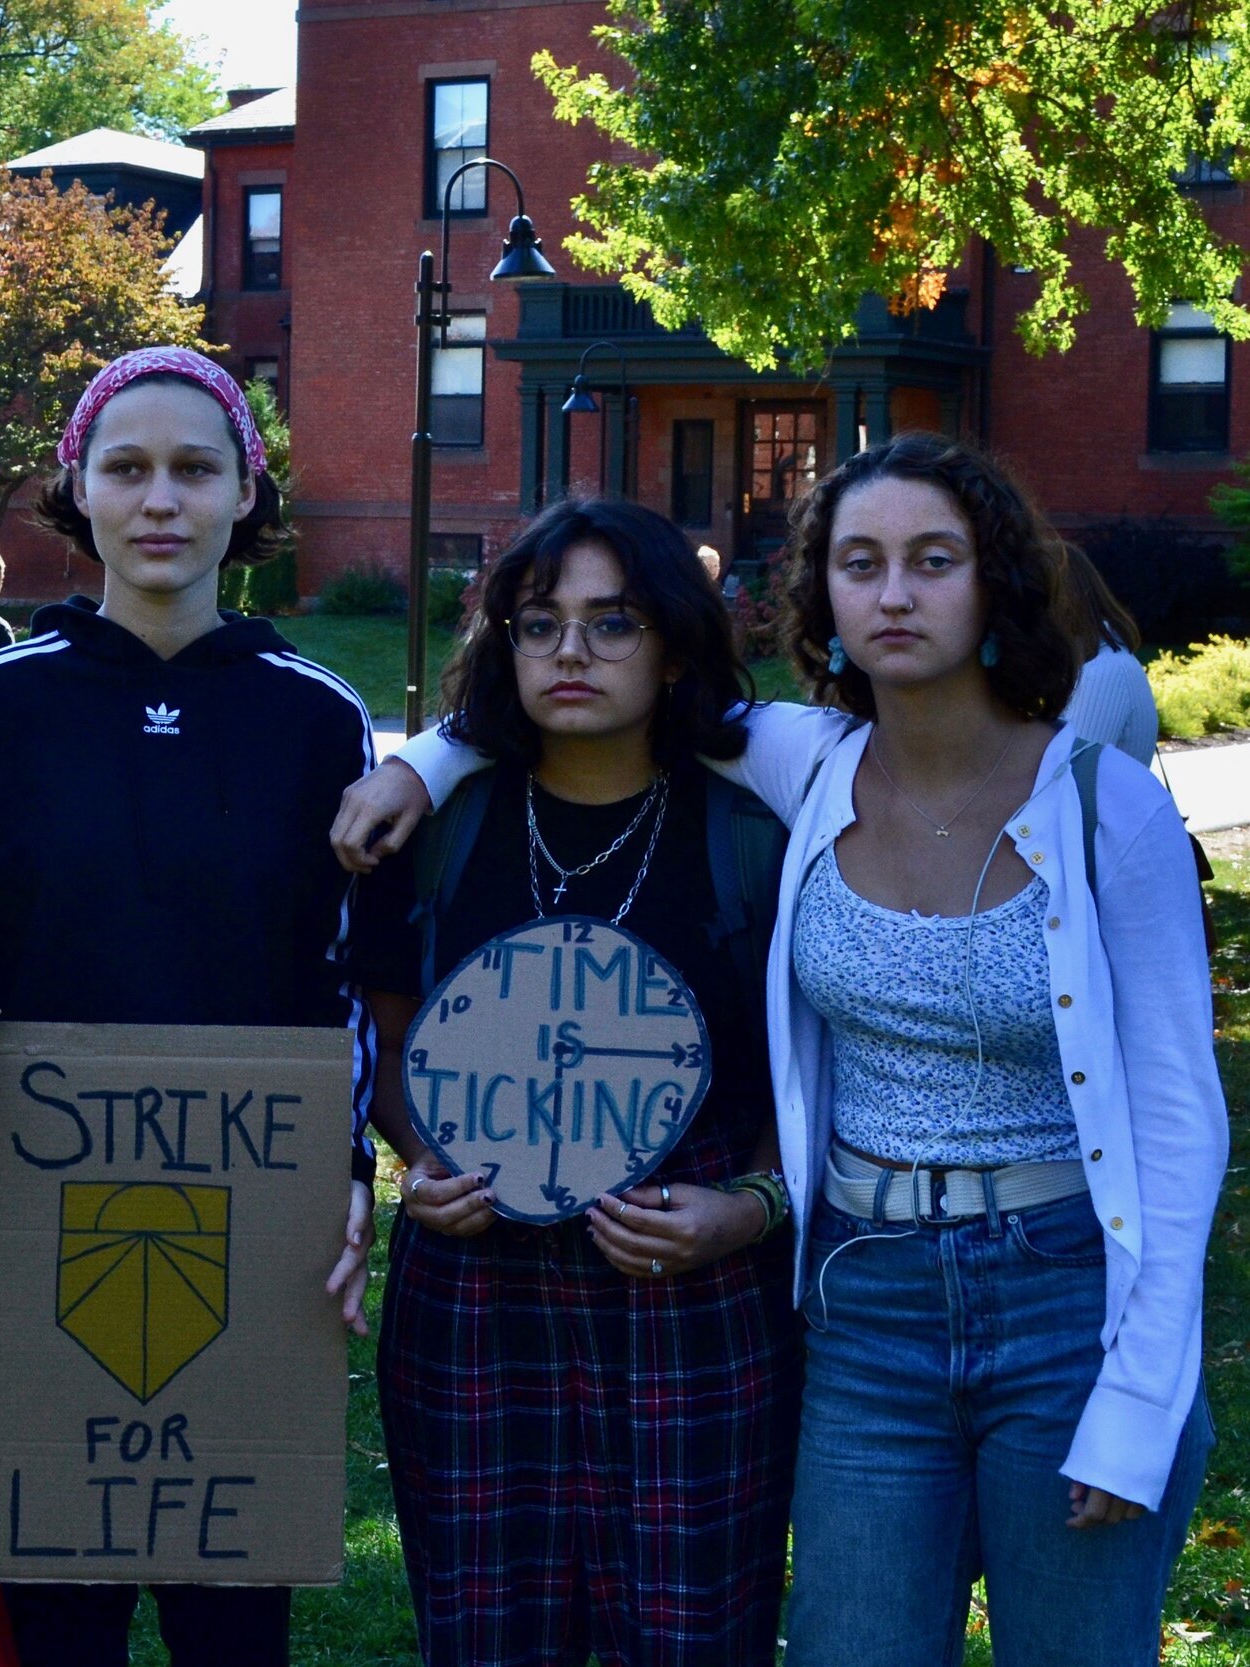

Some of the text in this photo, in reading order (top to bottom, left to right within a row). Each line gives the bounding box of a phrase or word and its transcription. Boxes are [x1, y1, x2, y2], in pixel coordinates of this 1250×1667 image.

[143, 725, 180, 734] adidas
[563, 923, 595, 943] 12
[486, 941, 689, 1017] TIME
[439, 995, 472, 1024] 10
[667, 988, 684, 1007] 2
[537, 1021, 585, 1069] IS
[685, 1043, 702, 1068] 3
[410, 1049, 428, 1072] 9
[12, 1062, 302, 1172] STRIKE
[411, 1067, 686, 1151] TICKING
[665, 1097, 682, 1121] 4
[438, 1122, 458, 1145] 8
[625, 1148, 650, 1173] 5
[480, 1163, 501, 1188] 7
[86, 1413, 194, 1464] FOR
[10, 1469, 256, 1559] LIFE
